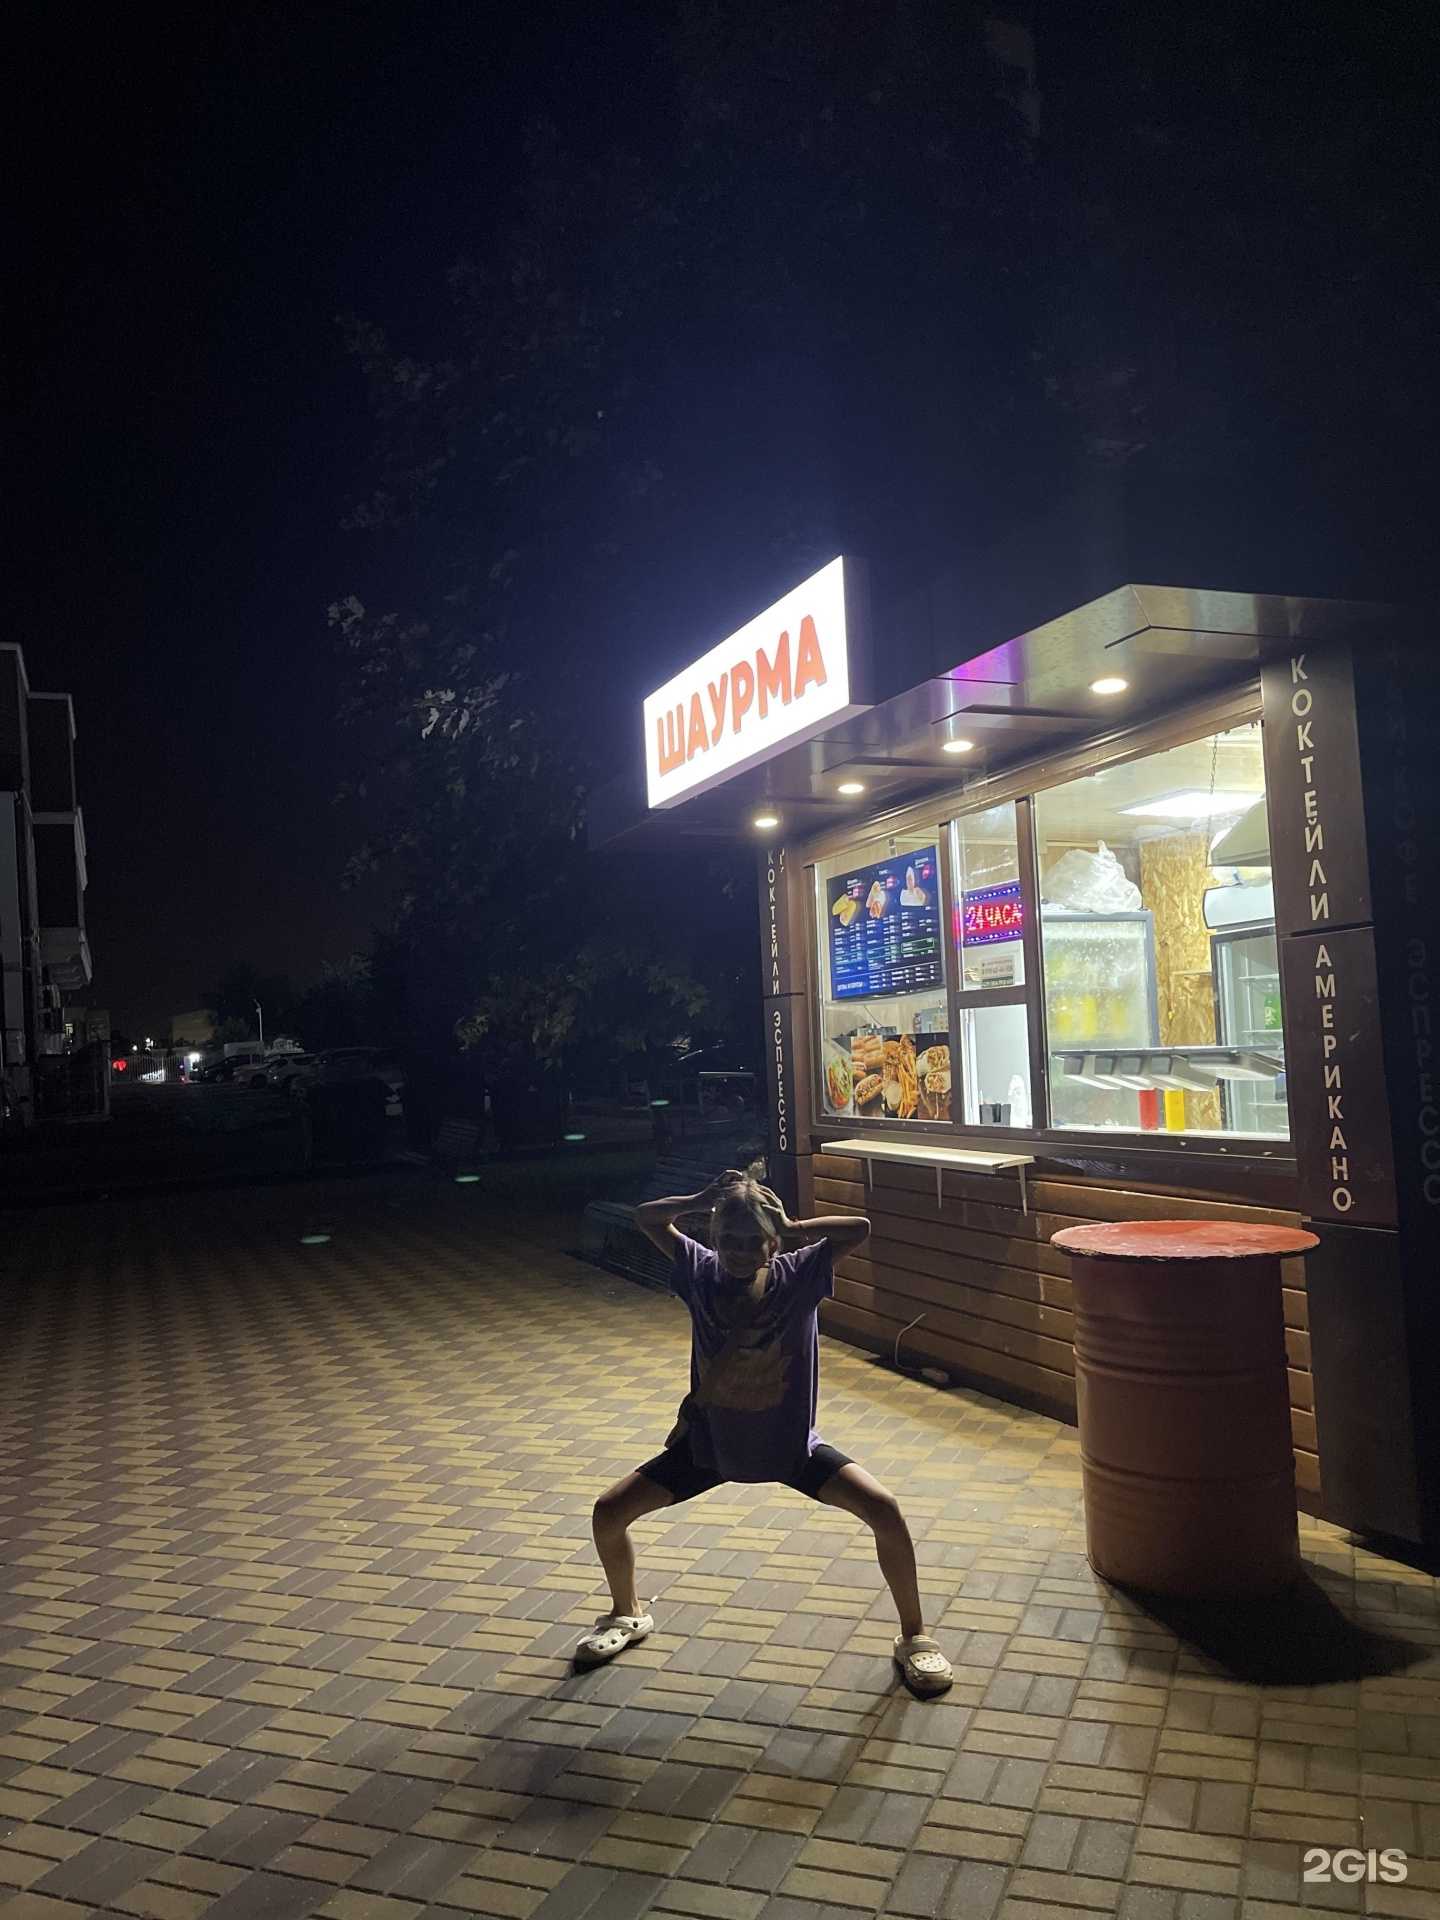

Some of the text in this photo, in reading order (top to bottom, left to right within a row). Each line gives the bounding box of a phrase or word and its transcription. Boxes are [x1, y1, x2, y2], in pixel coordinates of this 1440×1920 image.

[657, 614, 828, 777] ШАУРМА
[1290, 654, 1330, 921] КОКТЕЙЛИ
[767, 849, 781, 994] КОКТЕЙЛИ
[773, 1011, 788, 1151] ЭСПРЕССО
[1315, 944, 1352, 1212] АМЕРИКАНО
